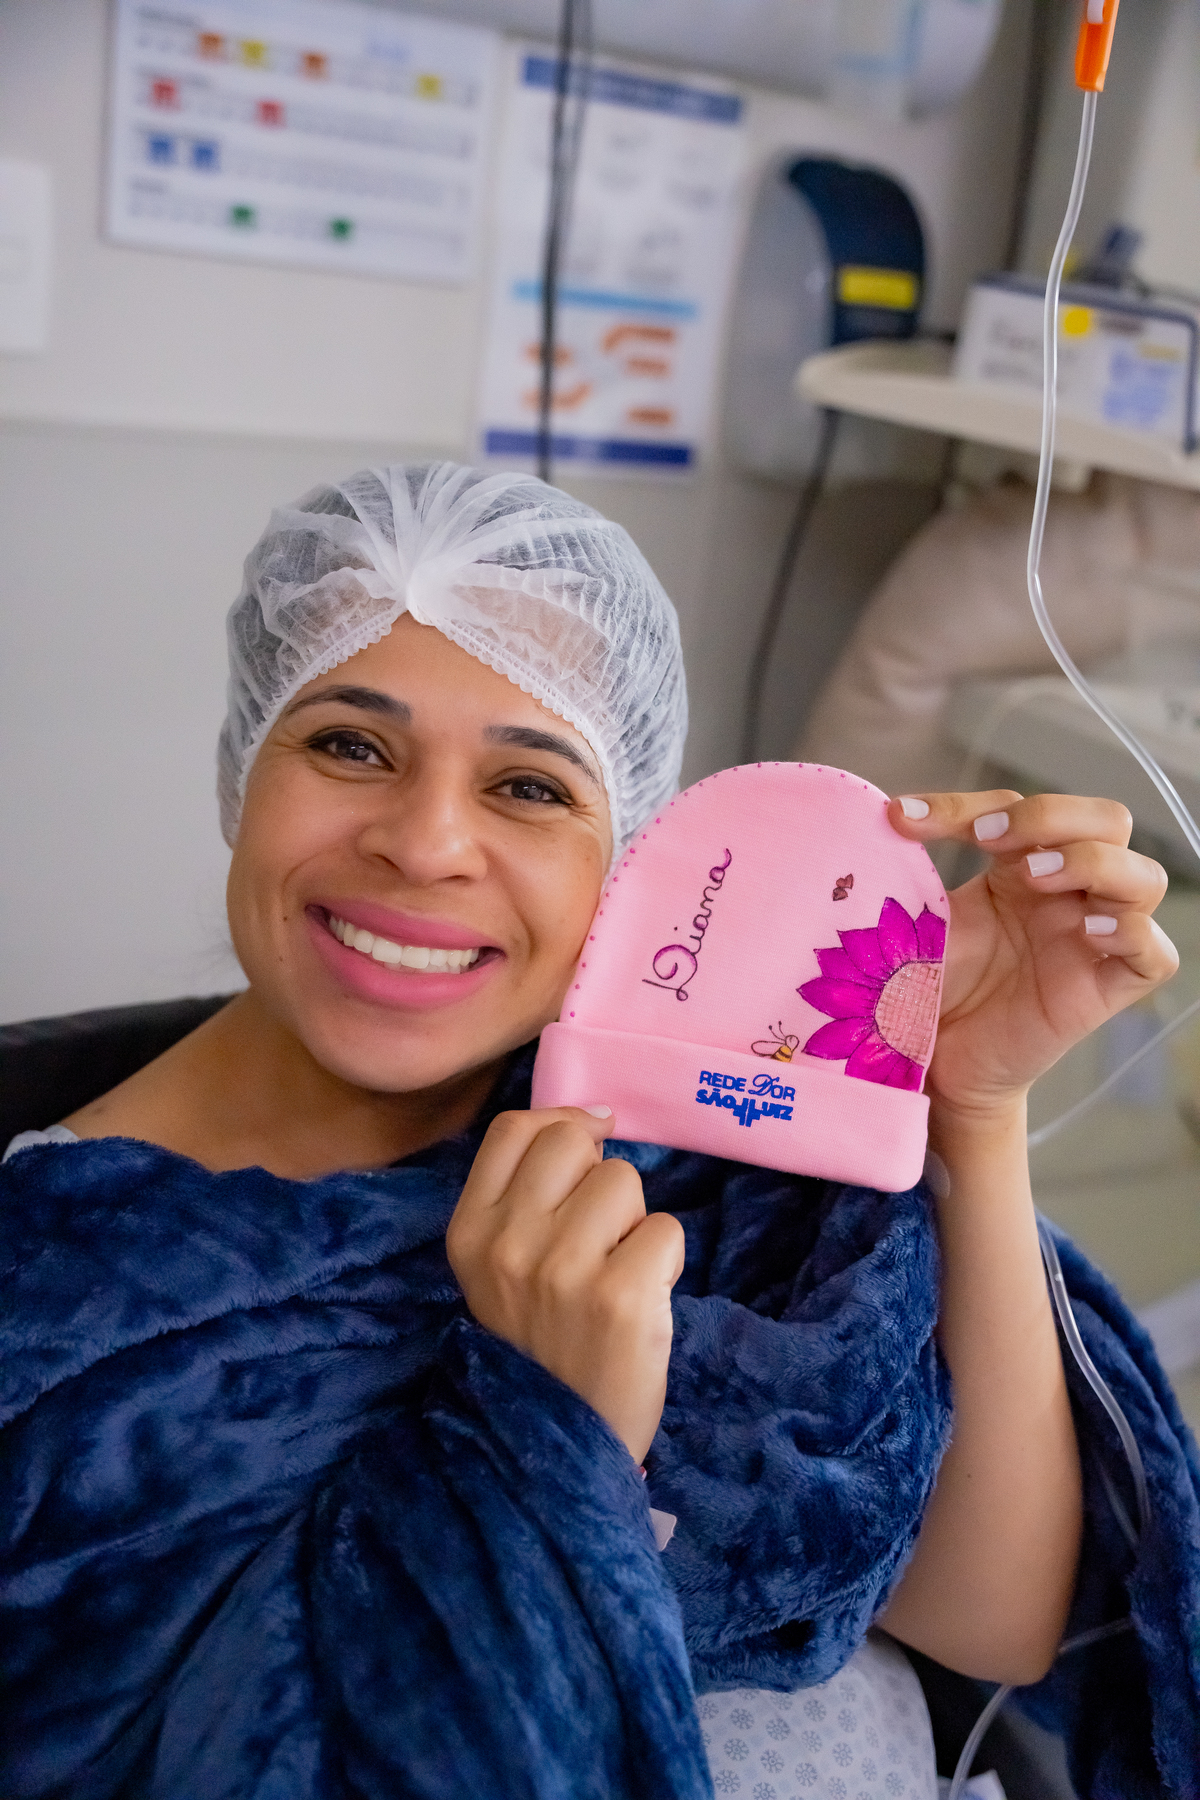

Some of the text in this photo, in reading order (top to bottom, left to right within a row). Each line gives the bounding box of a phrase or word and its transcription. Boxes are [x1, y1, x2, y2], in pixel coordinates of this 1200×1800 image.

[642, 848, 732, 1001] Diana
[699, 1070, 747, 1092] REDE
[695, 1088, 737, 1110] SÃO
